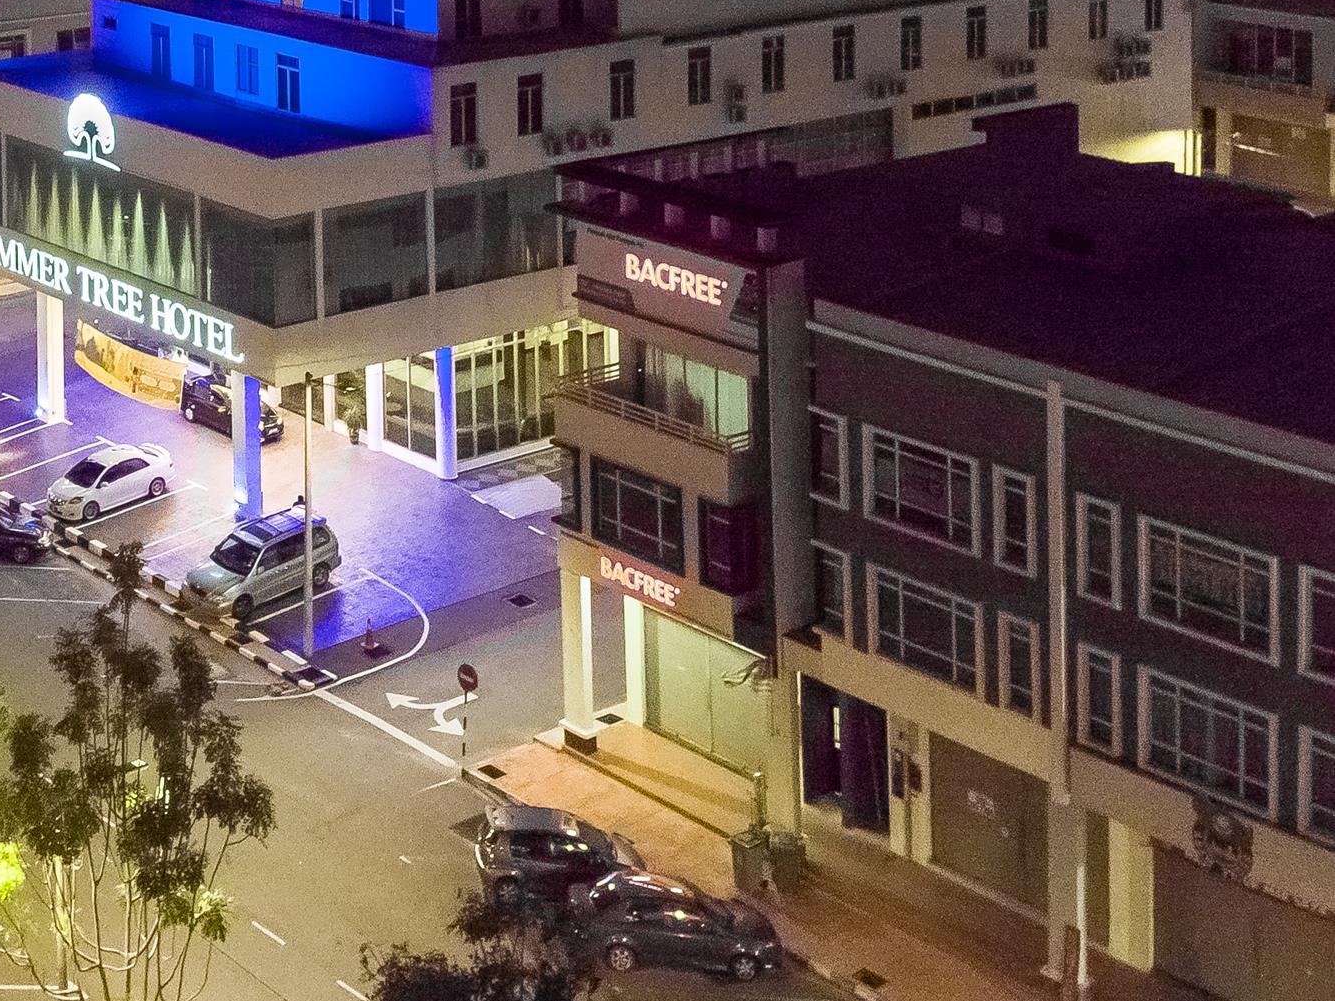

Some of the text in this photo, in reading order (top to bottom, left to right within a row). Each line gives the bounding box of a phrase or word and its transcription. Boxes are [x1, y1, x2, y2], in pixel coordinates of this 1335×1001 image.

[626, 253, 723, 306] BACFREE
[76, 266, 145, 324] TREE
[149, 294, 244, 363] HOTEL
[601, 556, 677, 607] BACFREE
